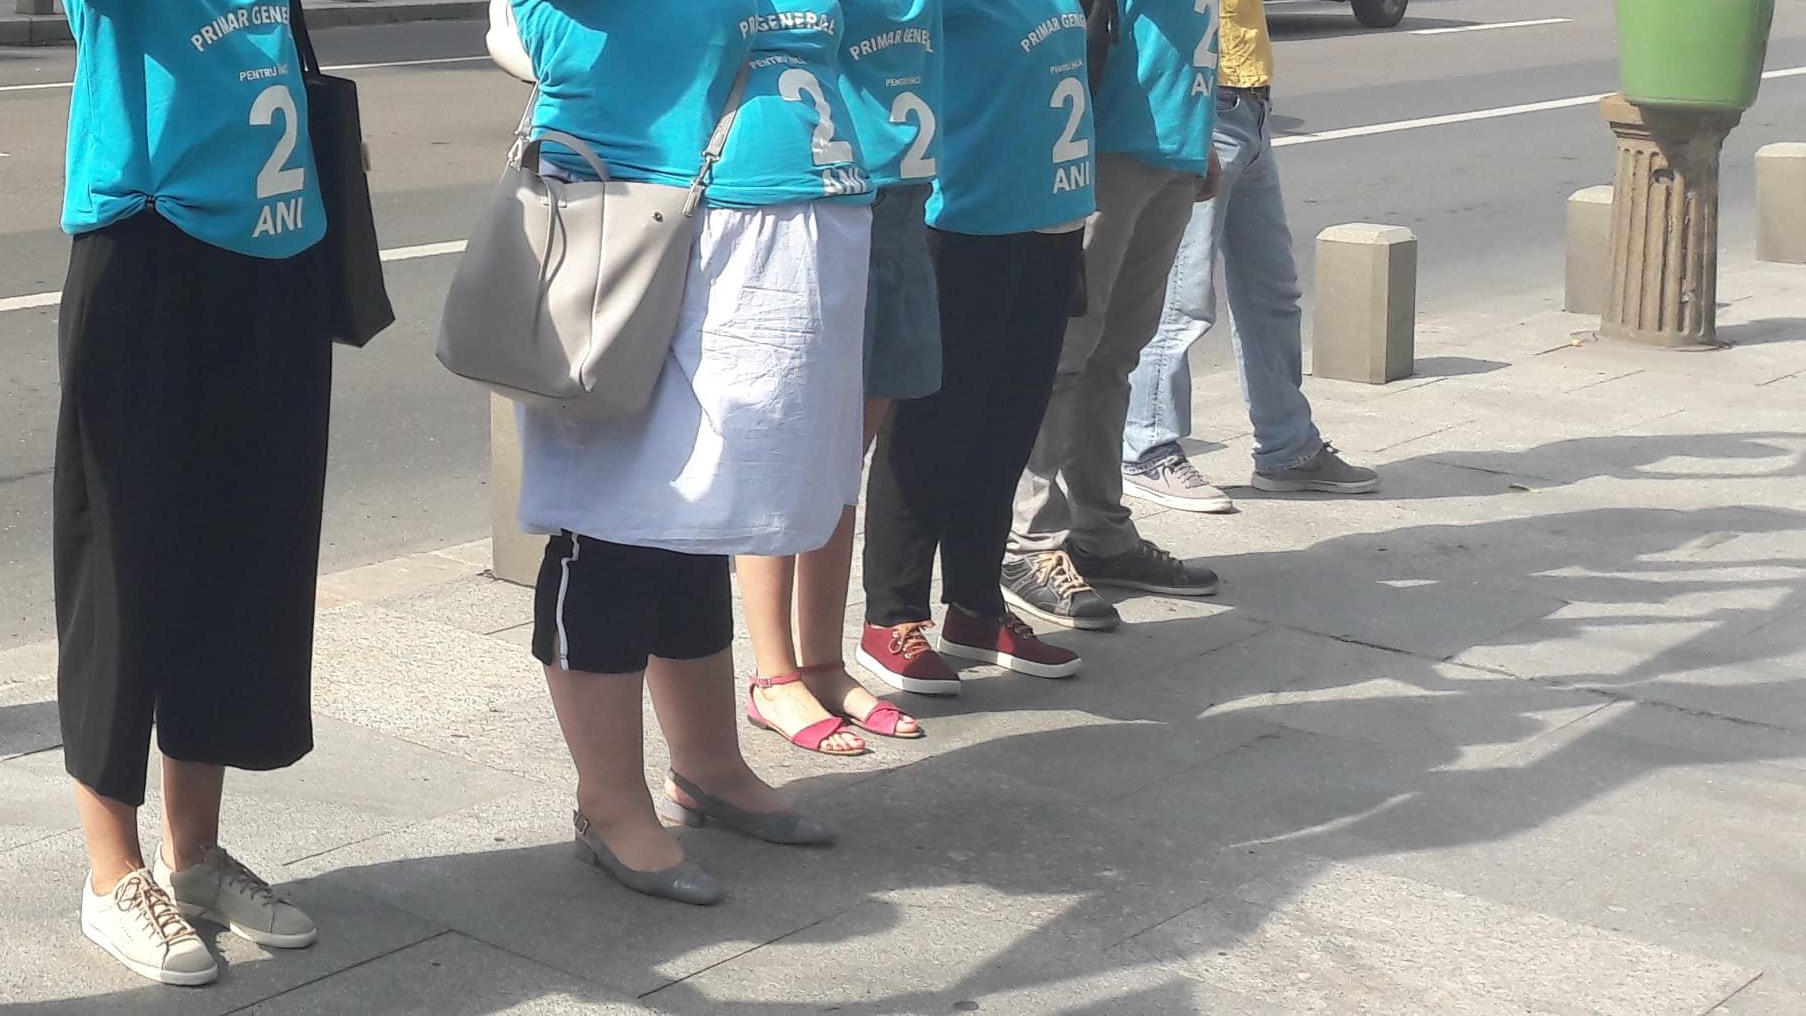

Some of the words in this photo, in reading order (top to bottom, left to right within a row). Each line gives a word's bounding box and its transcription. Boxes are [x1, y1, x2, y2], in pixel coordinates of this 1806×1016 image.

[190, 7, 250, 53] PRIMAR
[849, 29, 902, 60] PRIMAR
[1020, 17, 1061, 53] PRIMAR
[778, 68, 853, 166] 2
[889, 91, 937, 179] 2
[1049, 77, 1088, 164] 2
[249, 84, 305, 199] 2
[1052, 162, 1090, 194] ANI
[252, 197, 304, 238] ANI
